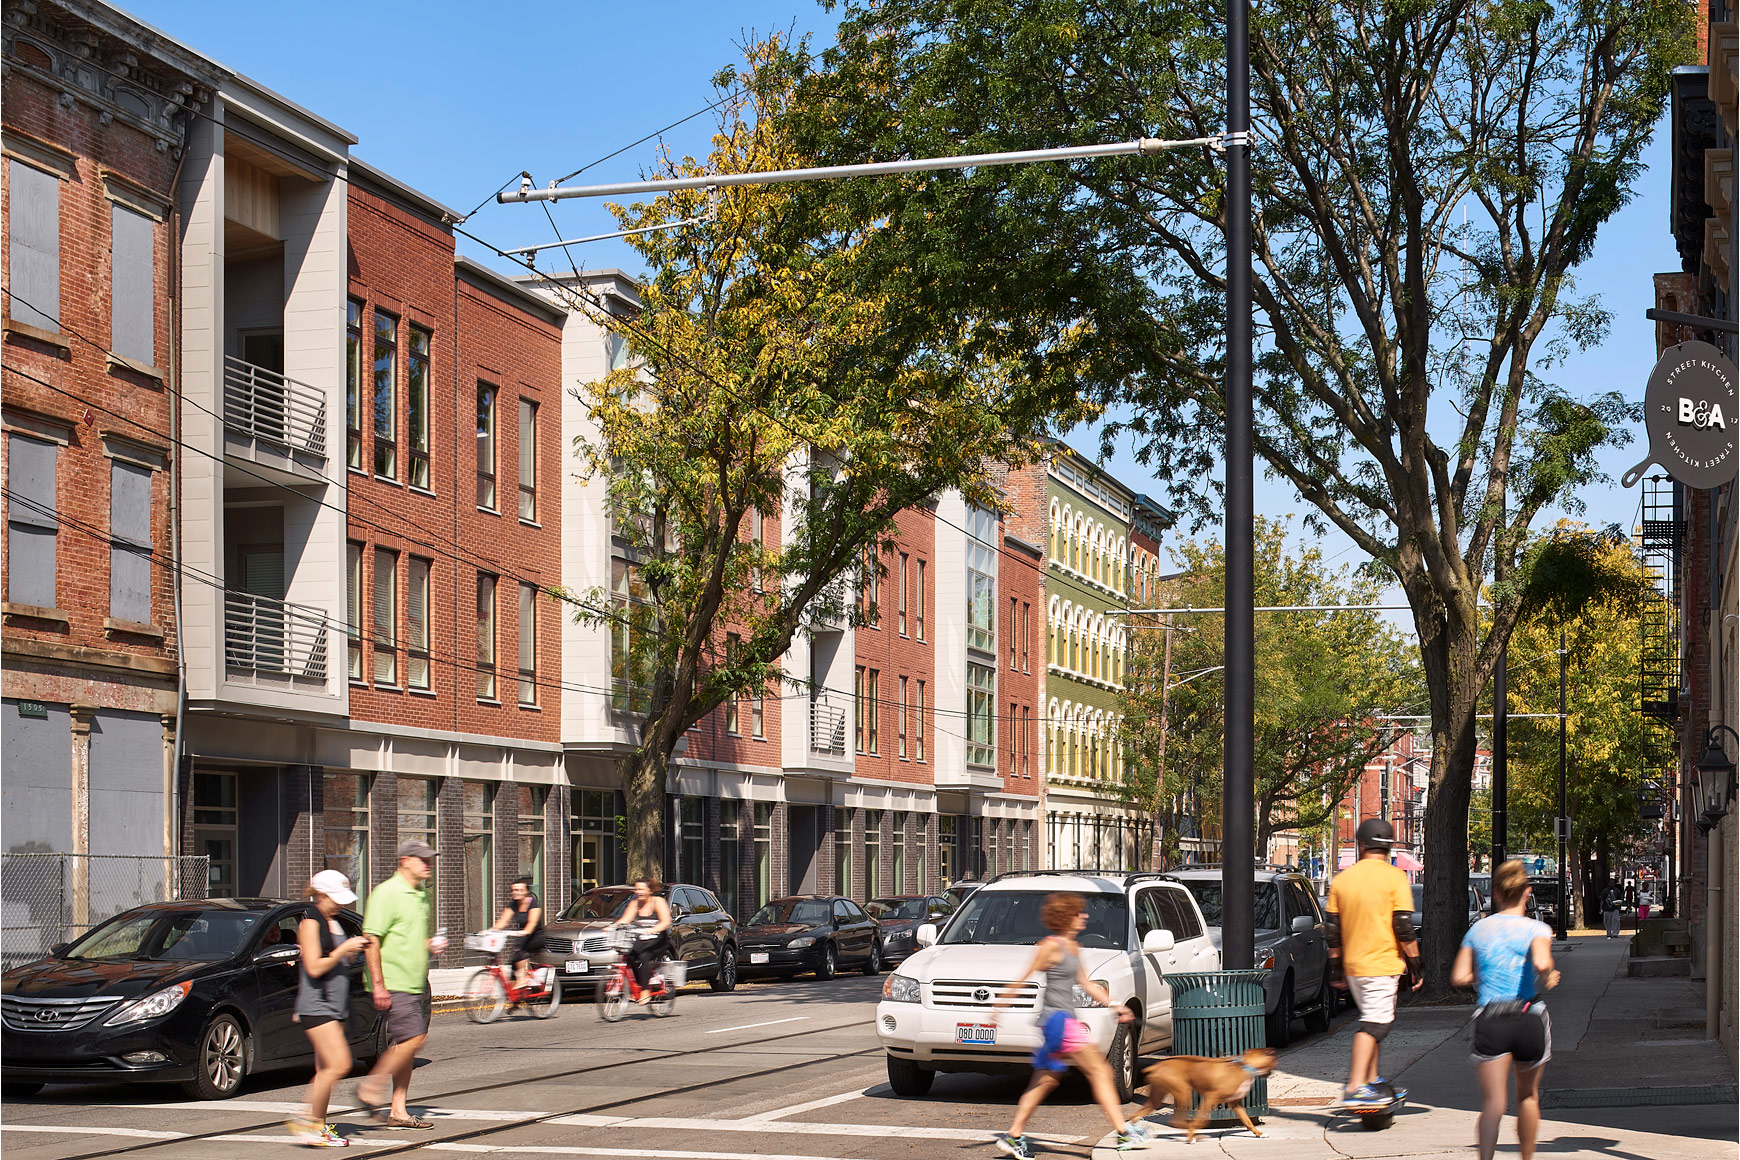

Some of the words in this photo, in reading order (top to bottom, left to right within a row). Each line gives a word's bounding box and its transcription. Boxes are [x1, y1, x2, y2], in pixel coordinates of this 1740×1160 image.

[1666, 359, 1697, 385] STREET
[1701, 360, 1735, 397] KITCHEN
[1678, 397, 1726, 430] B&A
[1665, 431, 1700, 468] KITCHEN
[1704, 441, 1733, 468] STREET
[23, 703, 43, 712] 1505
